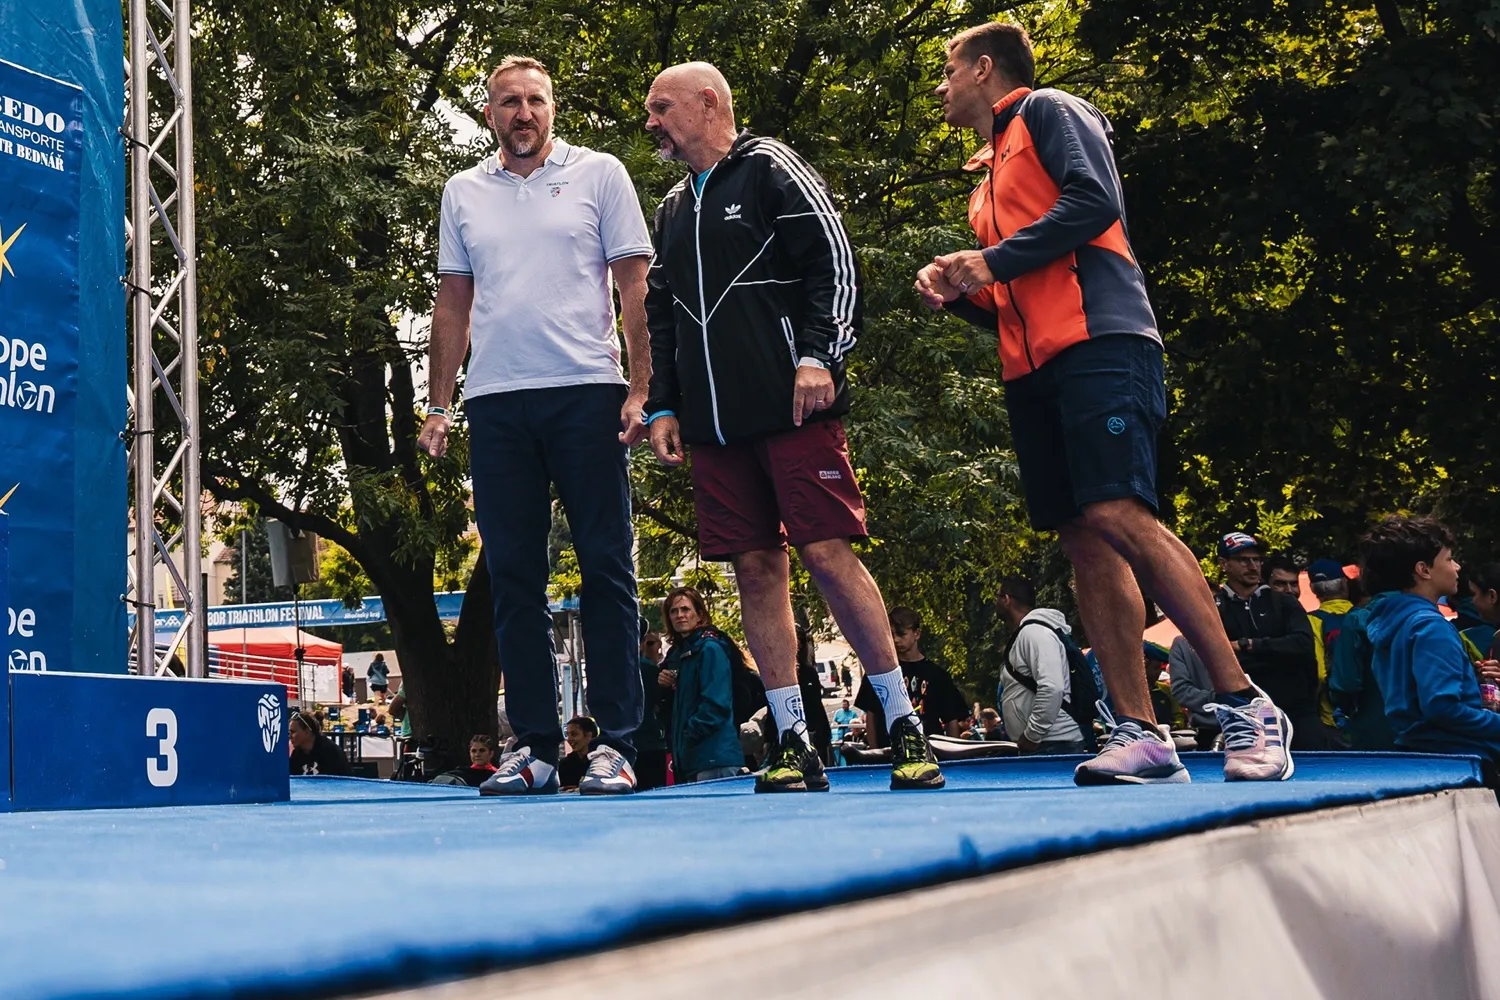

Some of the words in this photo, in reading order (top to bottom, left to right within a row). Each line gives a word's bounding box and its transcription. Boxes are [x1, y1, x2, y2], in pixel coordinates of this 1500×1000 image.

[16, 143, 64, 172] BEDNÁŘ
[207, 612, 226, 626] BOR
[227, 609, 279, 624] TRIATHLON
[146, 707, 178, 787] 3
